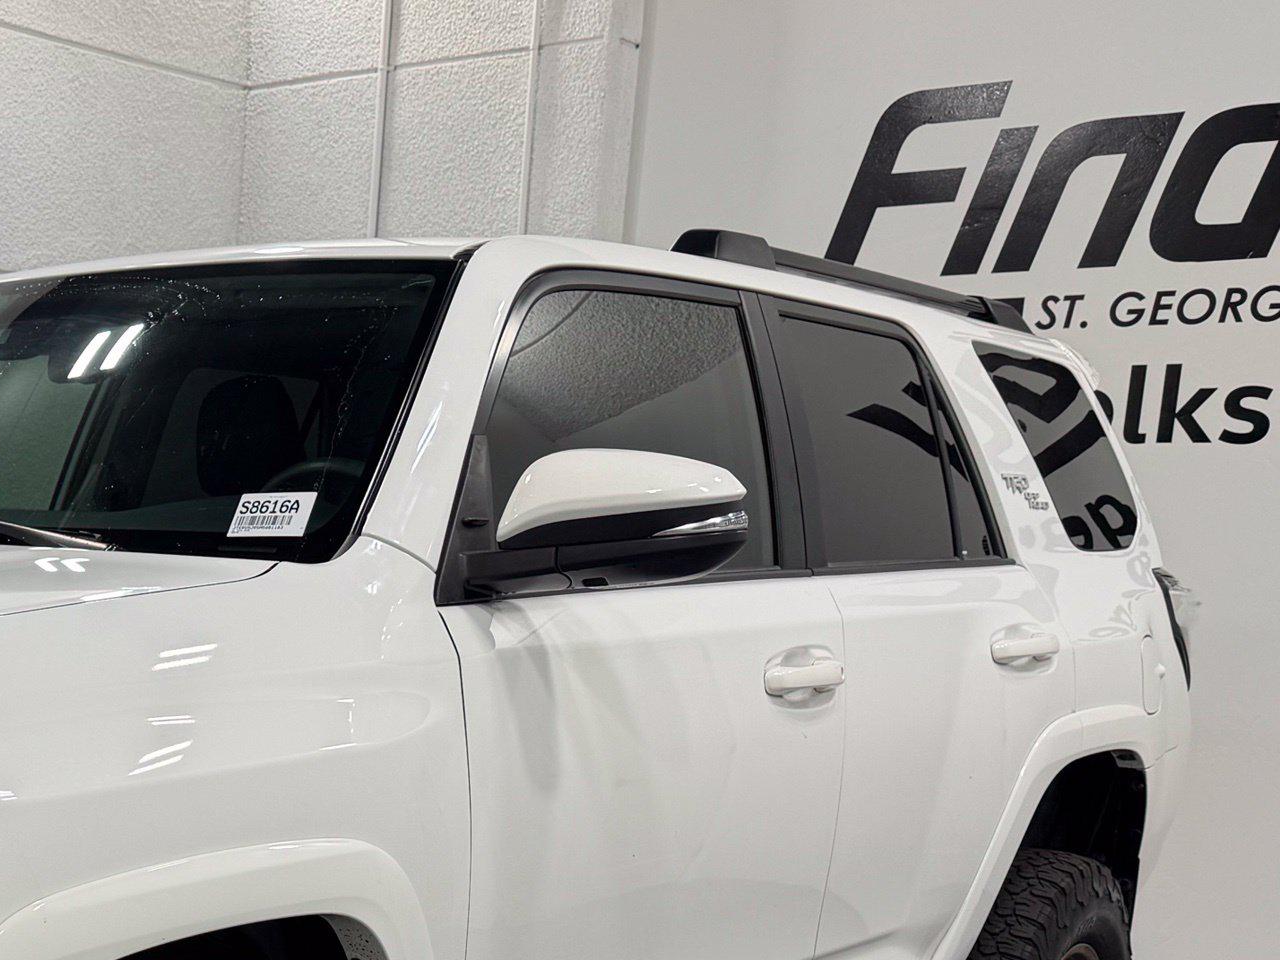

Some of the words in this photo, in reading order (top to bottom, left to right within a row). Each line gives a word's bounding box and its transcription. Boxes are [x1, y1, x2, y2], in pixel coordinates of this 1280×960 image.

[1034, 294, 1088, 330] ST.
[1109, 284, 1280, 328] GEORG
[1102, 363, 1274, 445] lks
[239, 499, 300, 514] S8616A
